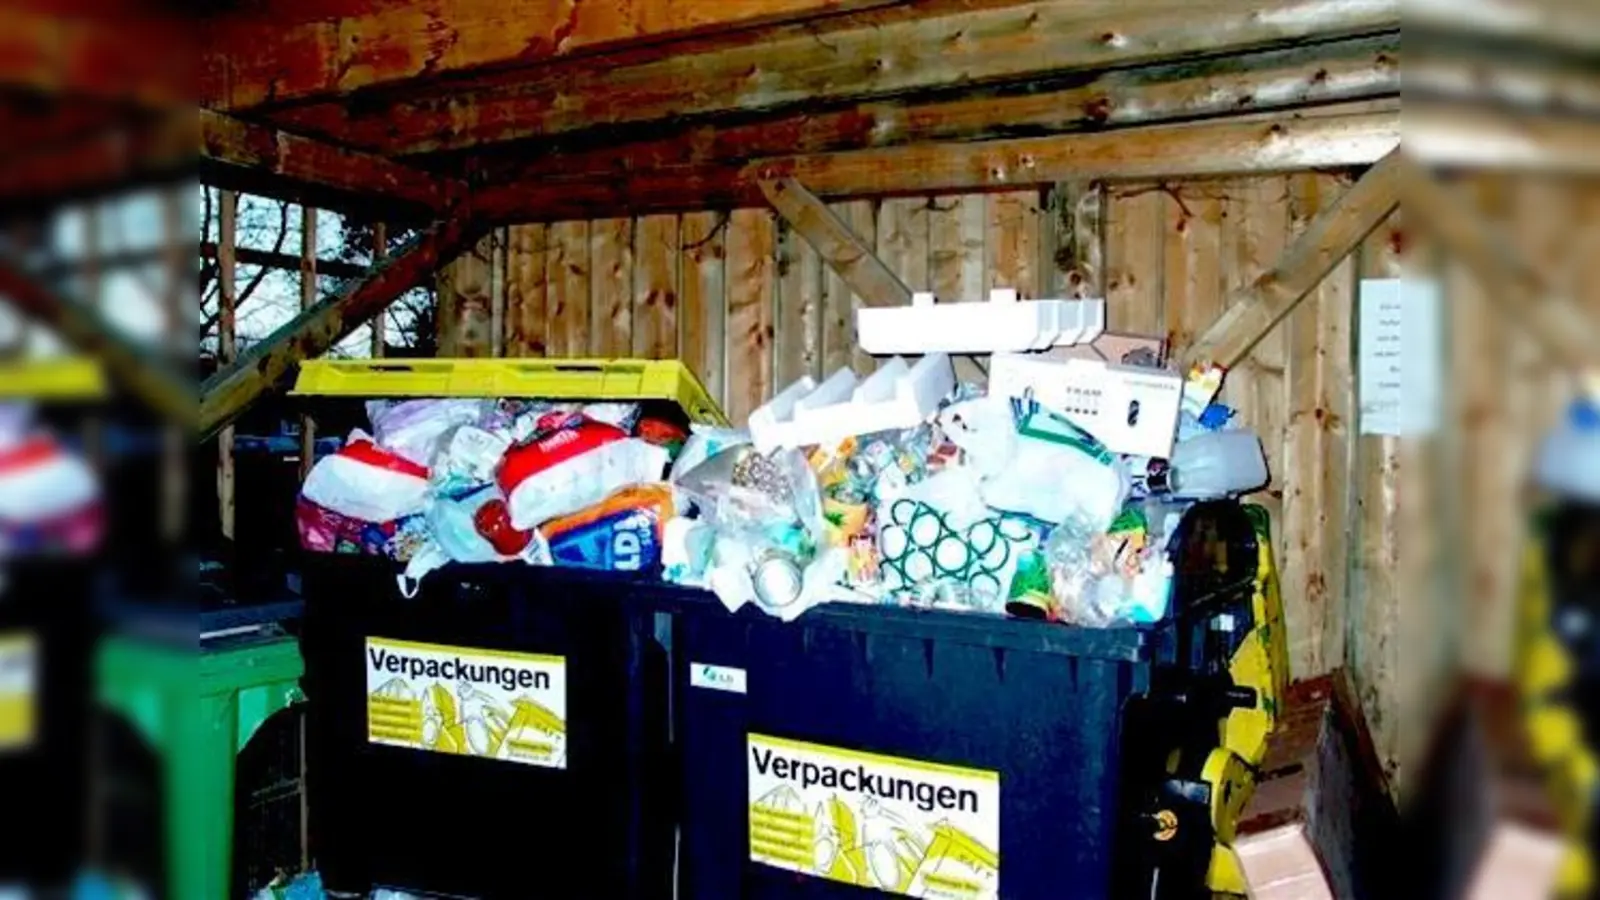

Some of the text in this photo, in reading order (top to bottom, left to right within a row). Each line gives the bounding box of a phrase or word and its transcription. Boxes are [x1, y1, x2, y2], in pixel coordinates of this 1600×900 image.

[613, 514, 641, 571] LDI
[369, 647, 550, 692] Verpackungen
[752, 747, 979, 813] Verpackungen
